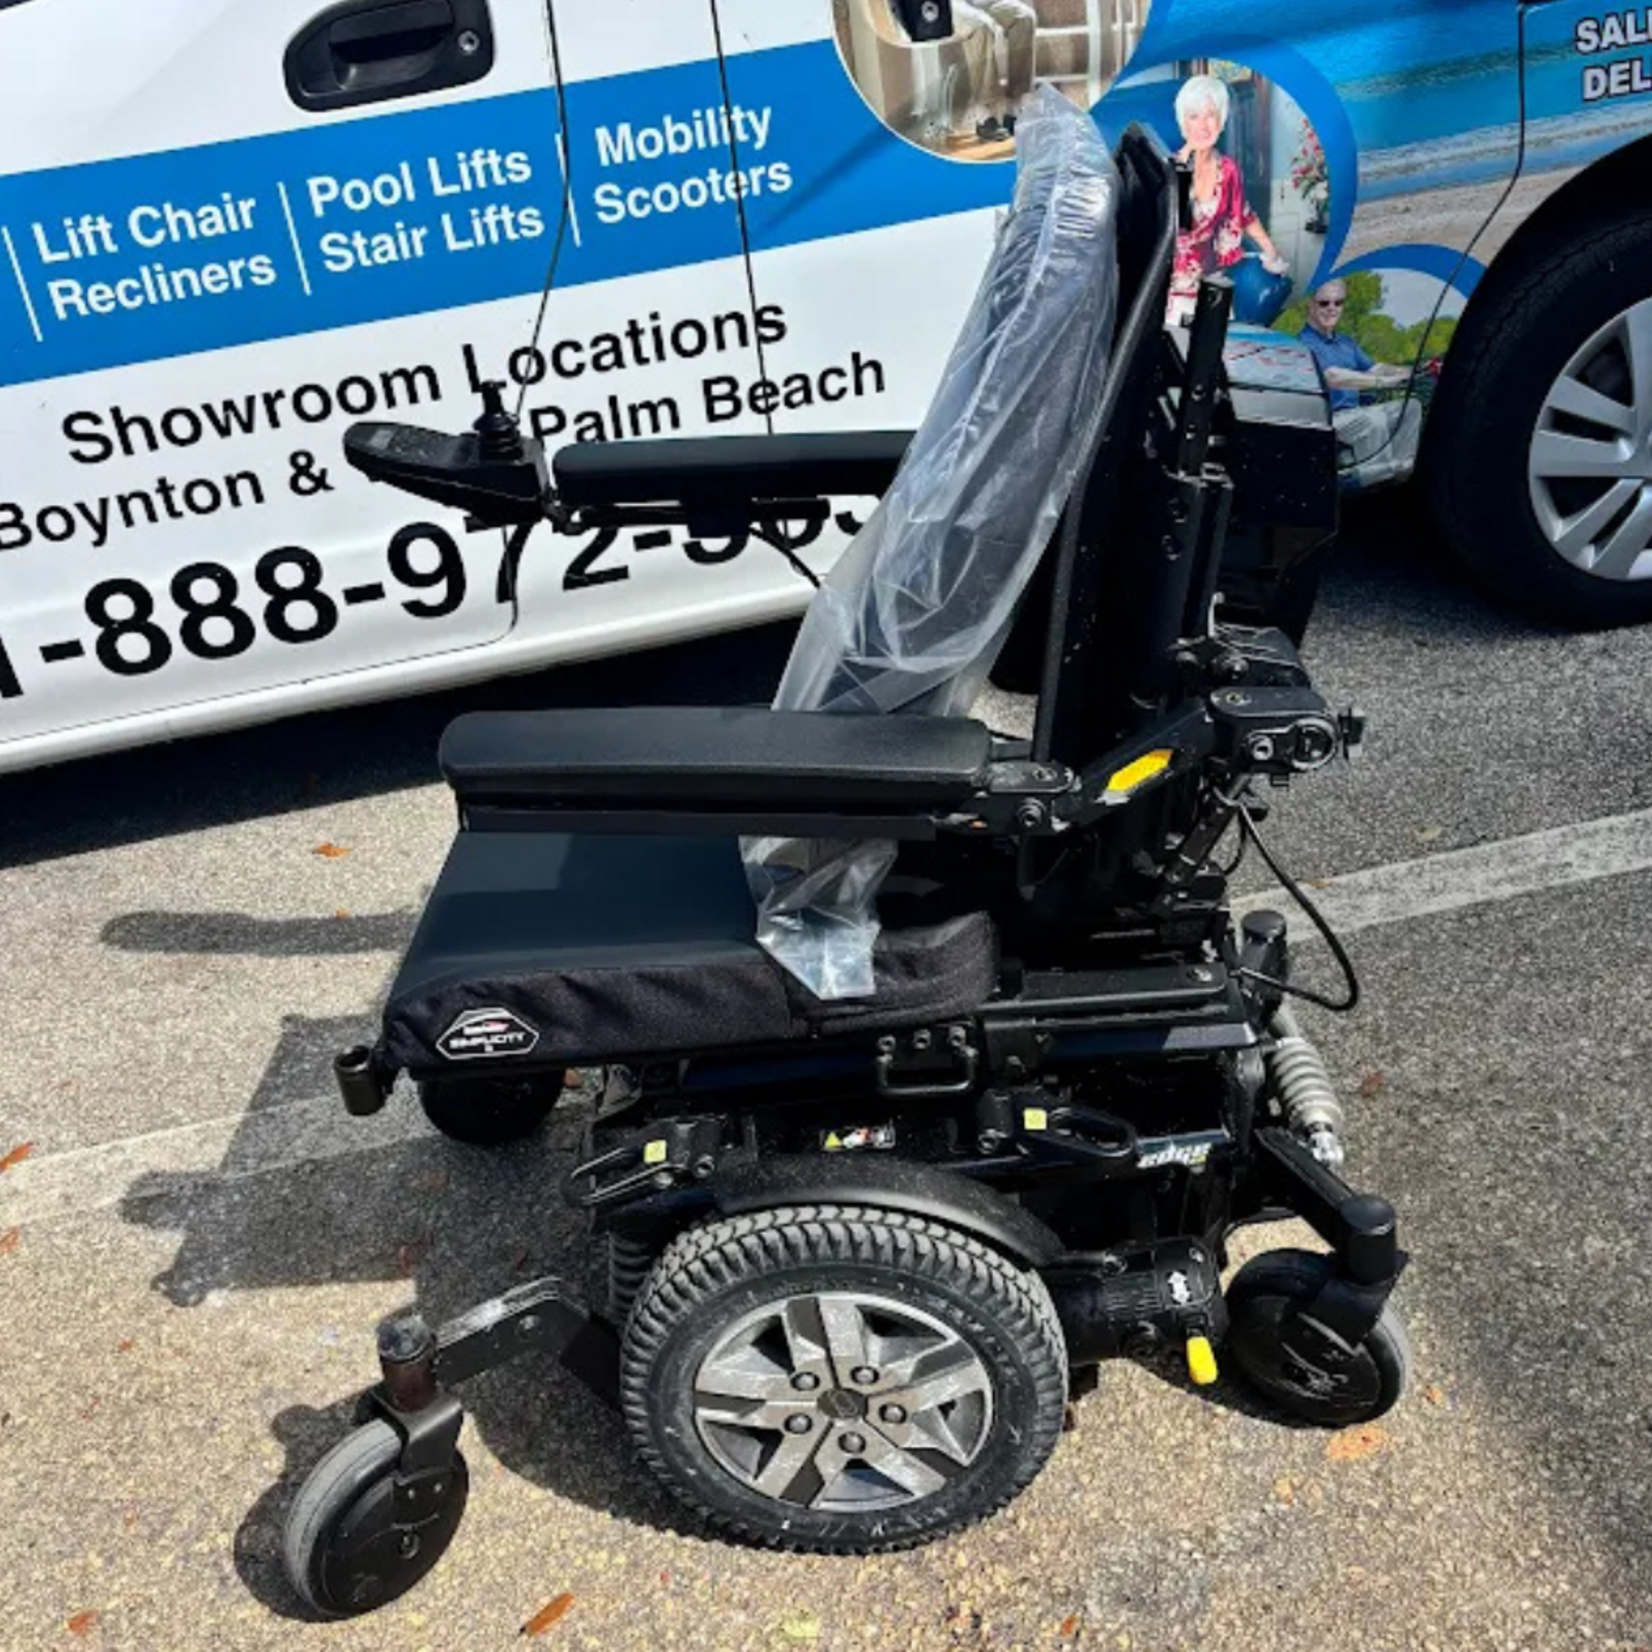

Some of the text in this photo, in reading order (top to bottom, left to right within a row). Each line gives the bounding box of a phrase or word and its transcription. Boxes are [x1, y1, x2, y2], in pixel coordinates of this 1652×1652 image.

[1576, 7, 1652, 54] SAL
[594, 104, 772, 167] Mobility
[307, 146, 532, 217] Pool Lifts
[593, 161, 793, 224] Scooters
[32, 192, 256, 263] Lift Chair
[319, 205, 545, 273] Stair Lifts
[47, 254, 277, 320] Recliners
[62, 303, 787, 464] Showroom Locations
[0, 351, 885, 550] Boynton & Palm Beach
